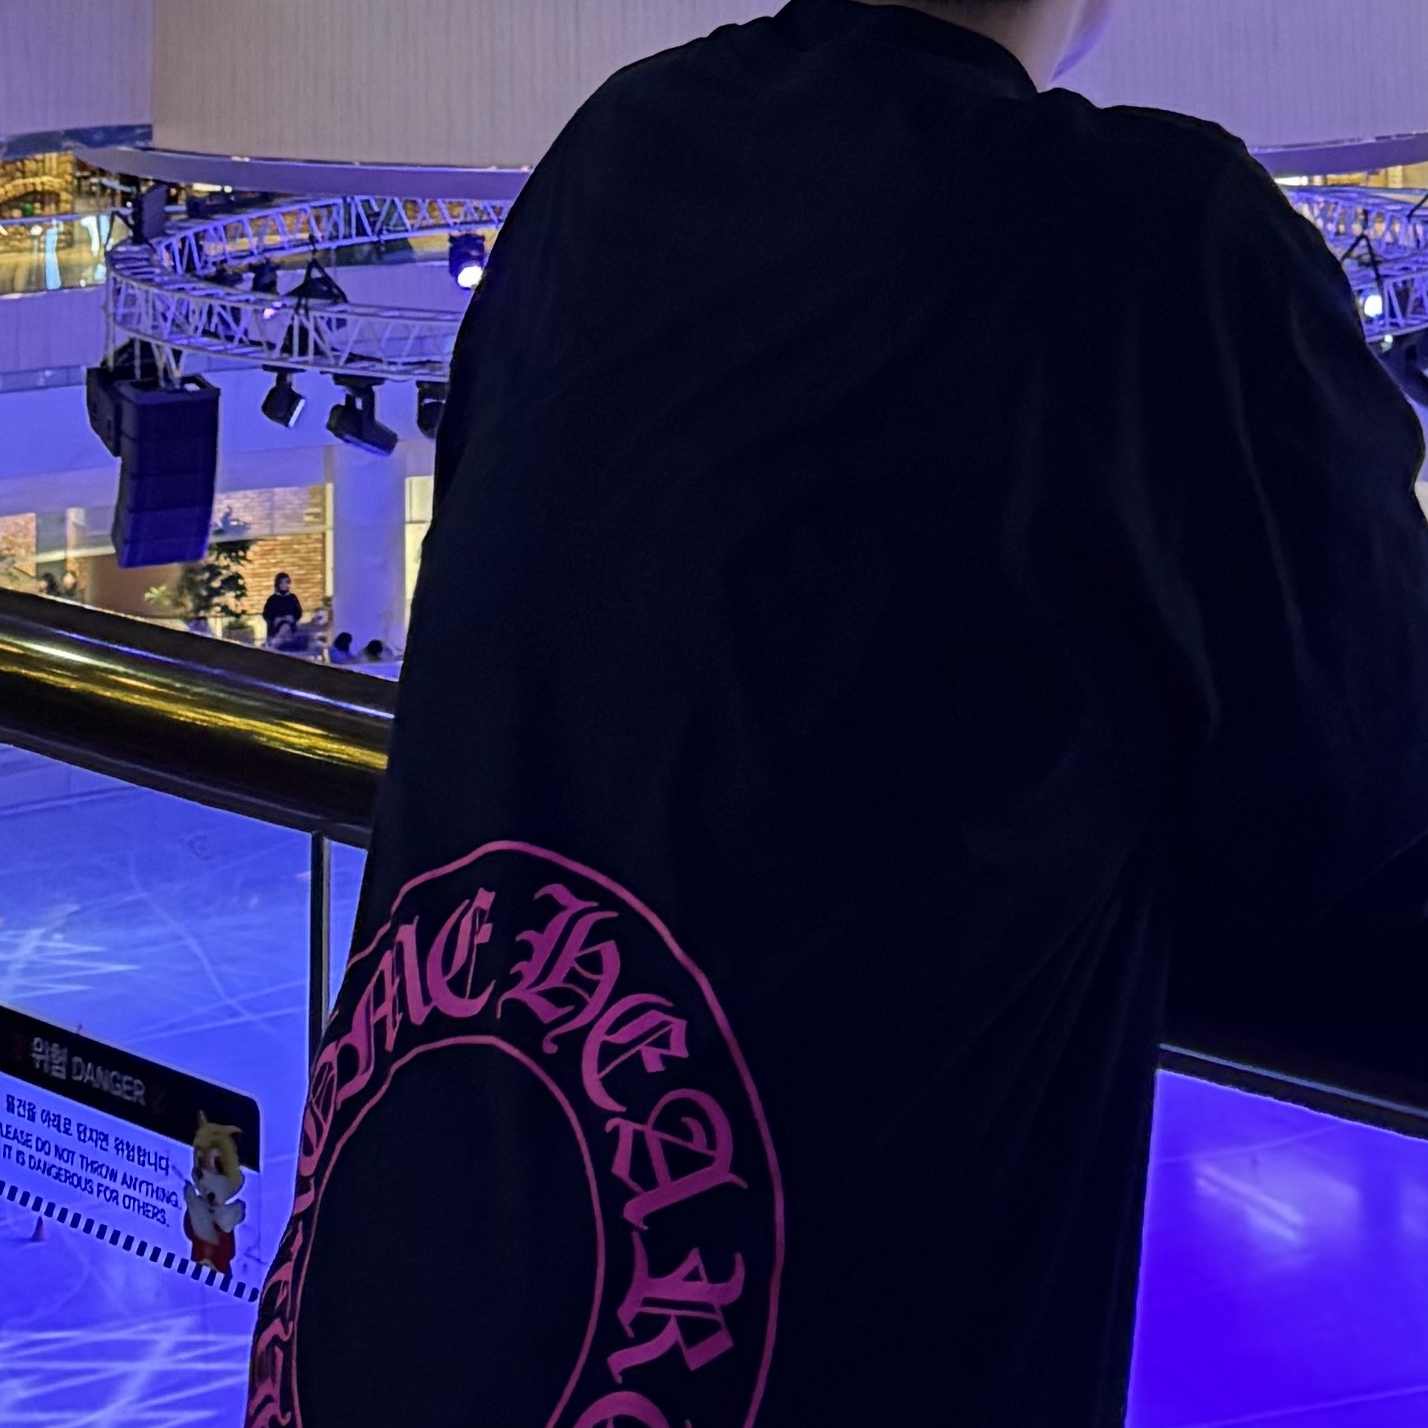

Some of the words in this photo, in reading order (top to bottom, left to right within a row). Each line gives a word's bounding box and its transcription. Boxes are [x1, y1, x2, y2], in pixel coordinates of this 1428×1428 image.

[29, 1036, 68, 1080] 위험
[71, 1055, 146, 1106] DANGER
[2, 1143, 13, 1160] IT
[28, 1154, 94, 1195] DANGEROUS
[96, 1182, 120, 1206] FOR
[35, 1136, 51, 1157] DO
[54, 1143, 76, 1167] NOT
[79, 1154, 118, 1184] THROW
